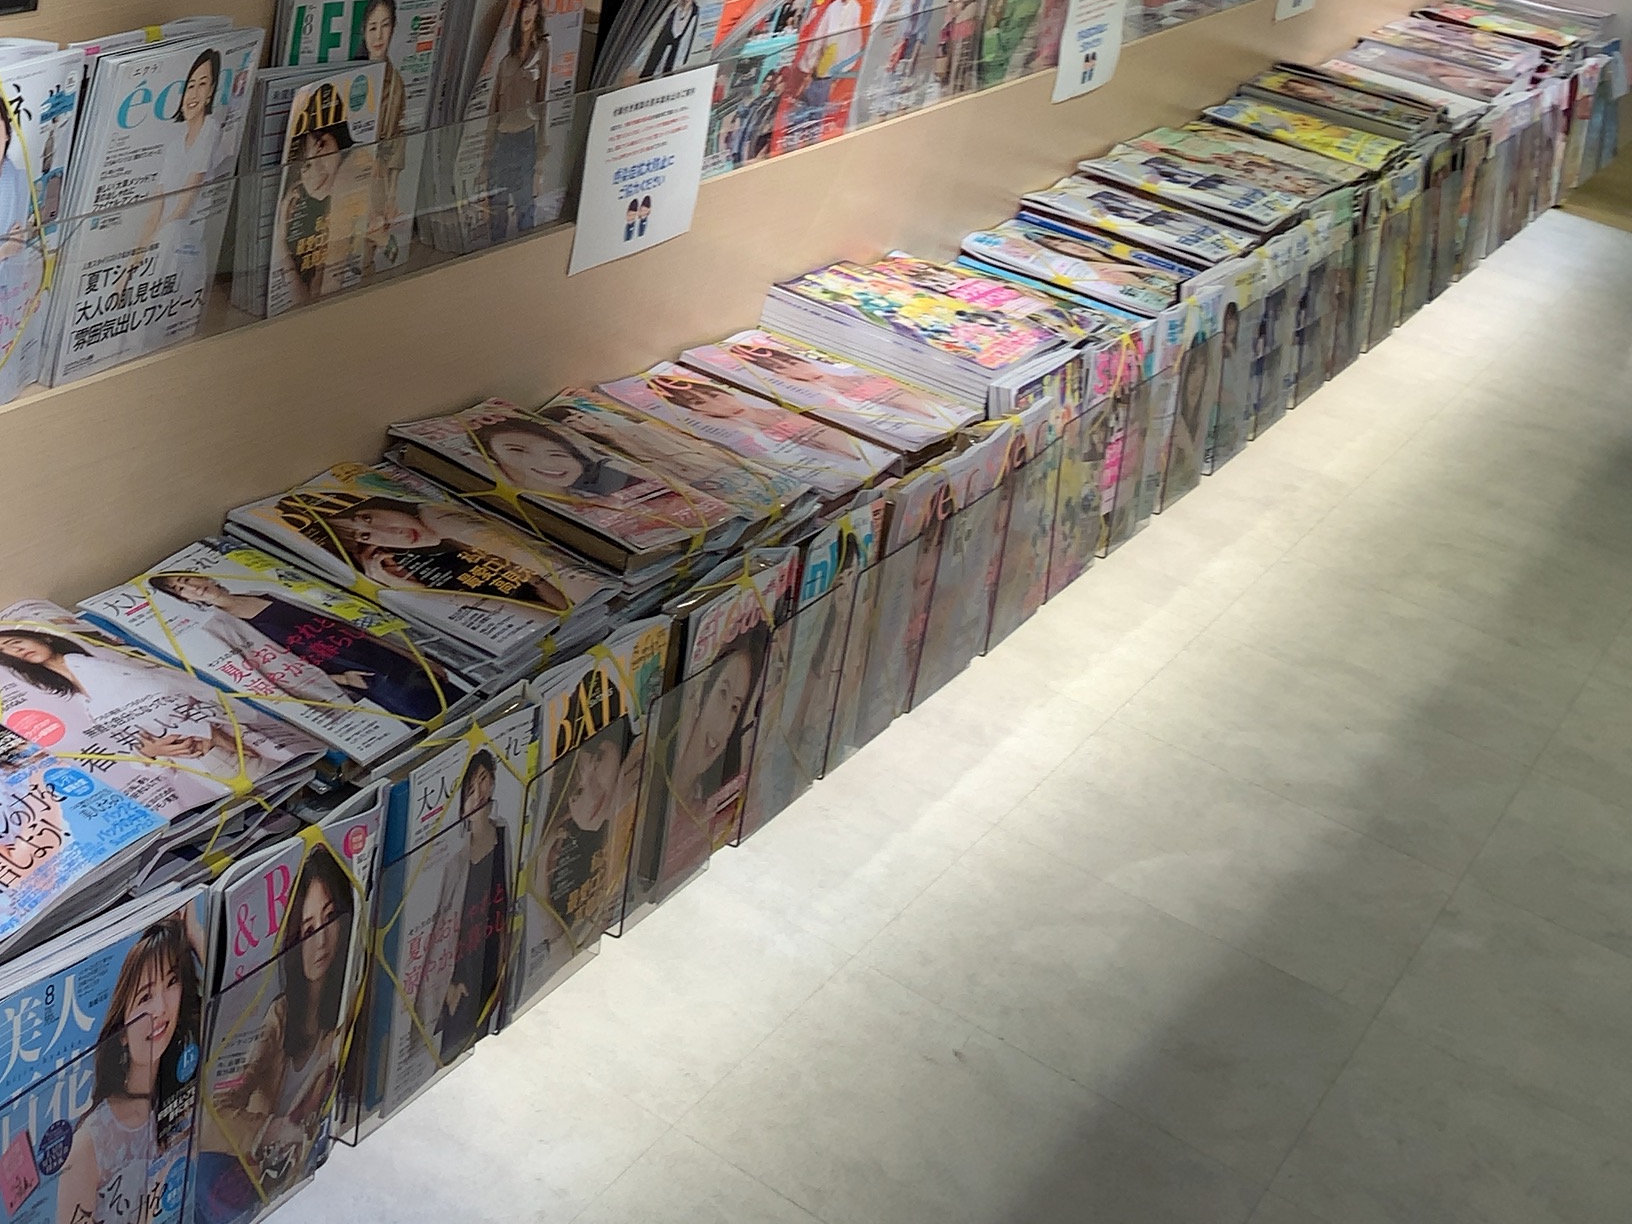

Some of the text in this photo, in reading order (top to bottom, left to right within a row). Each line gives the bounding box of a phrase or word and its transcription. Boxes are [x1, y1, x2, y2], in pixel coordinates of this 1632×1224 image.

[218, 617, 338, 683] 夏のおしゃれと
[44, 983, 56, 1007] 8
